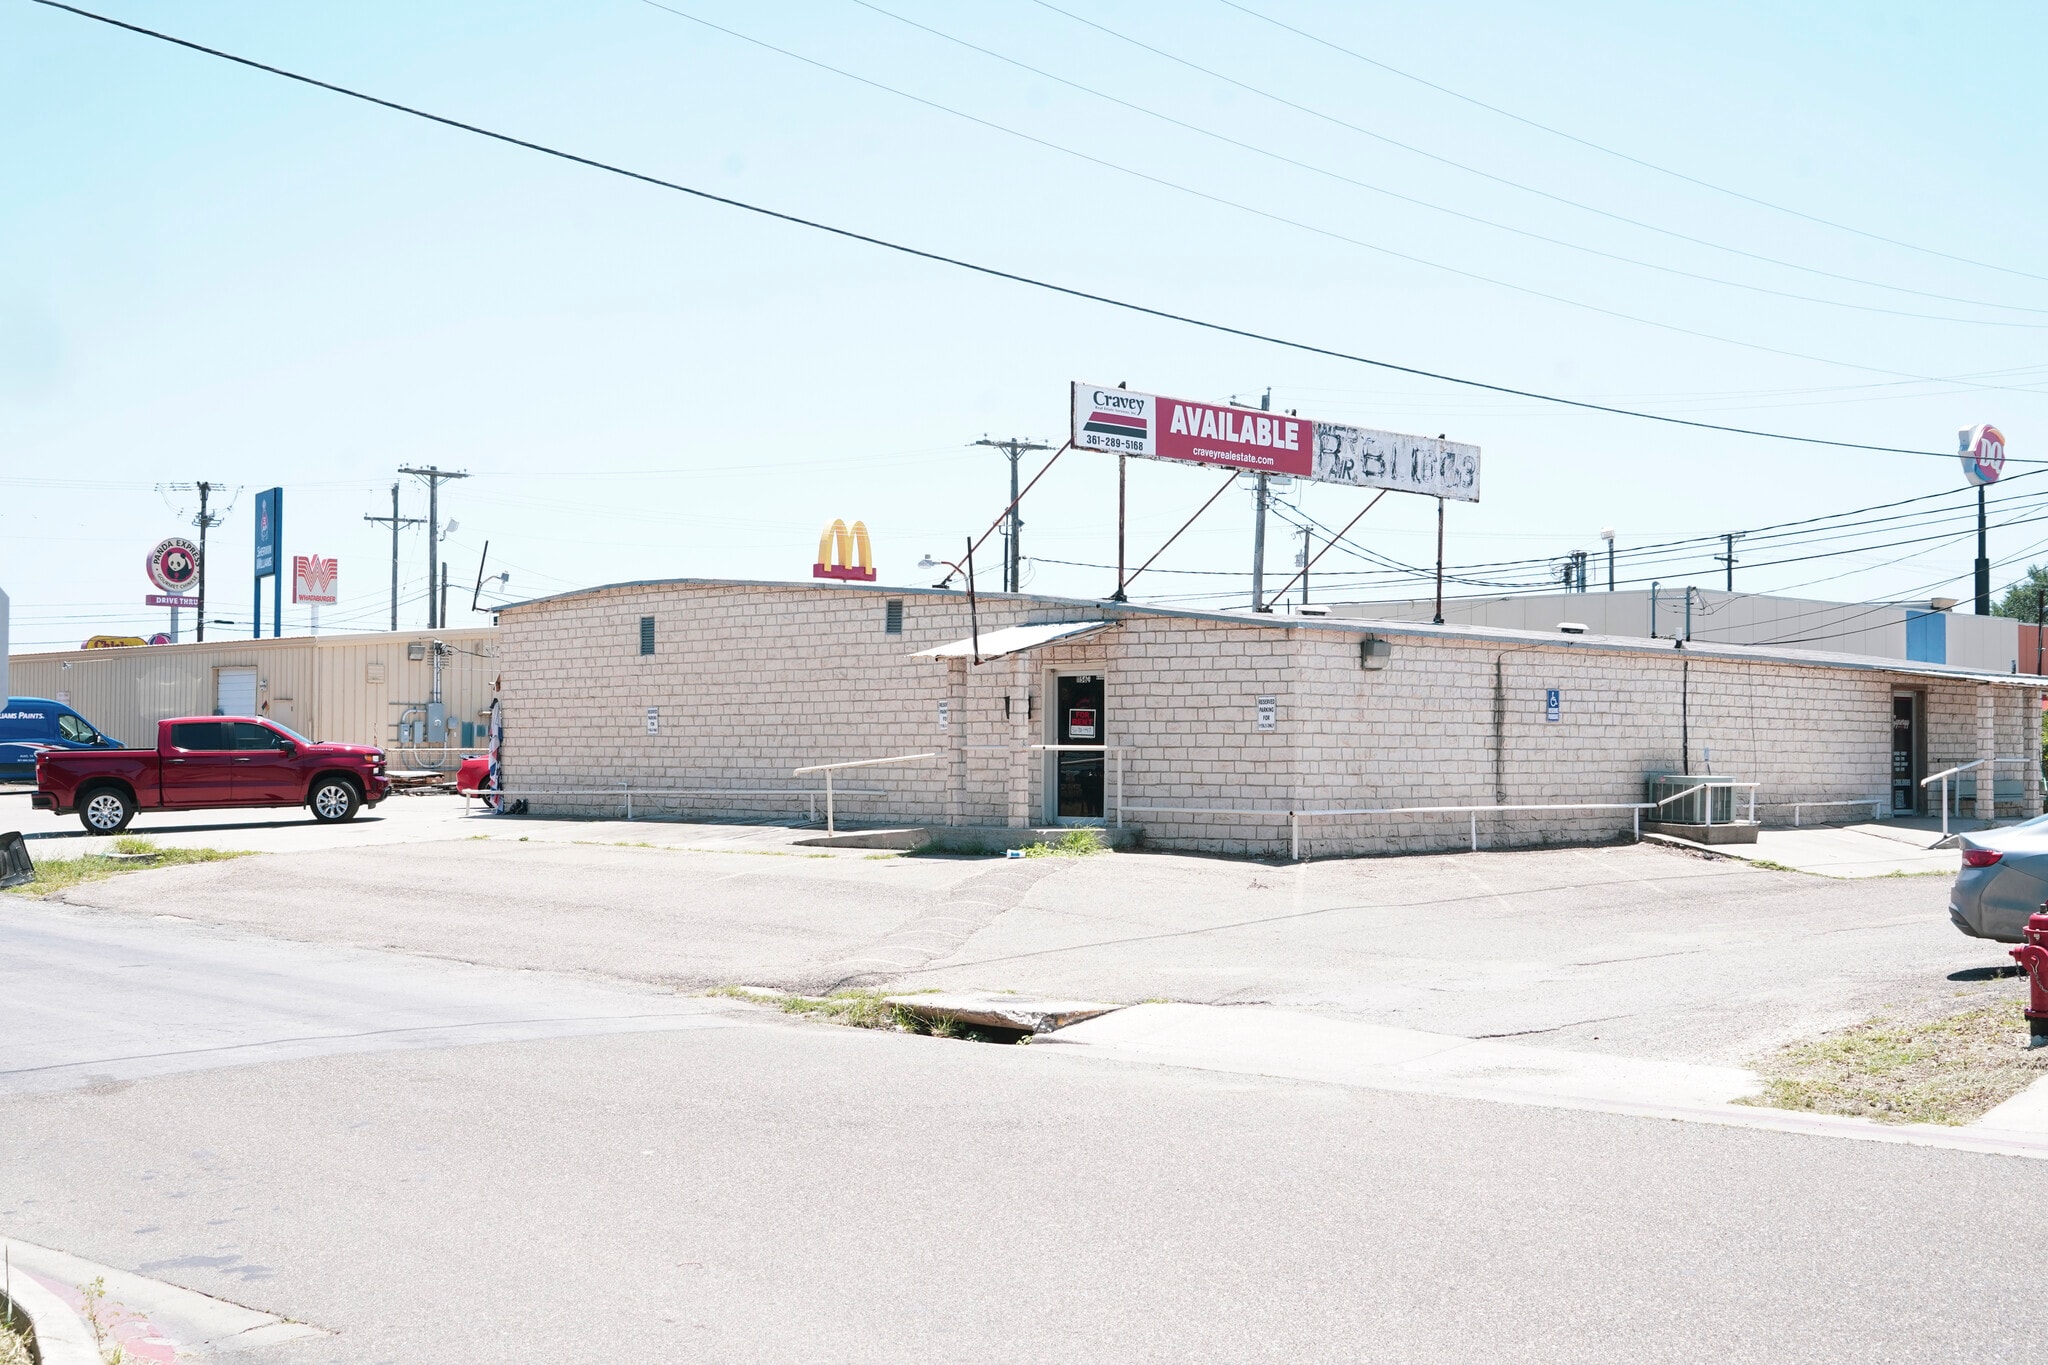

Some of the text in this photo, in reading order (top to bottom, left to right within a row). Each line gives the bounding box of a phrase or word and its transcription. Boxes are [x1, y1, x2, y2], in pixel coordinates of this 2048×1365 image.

[1093, 391, 1145, 416] Cravey
[1170, 404, 1299, 451] AVAILABLE
[1086, 434, 1144, 451] 361-289-5168
[1192, 446, 1274, 466] craveyrealestate.com
[1979, 437, 2003, 475] DQ
[153, 539, 200, 567] PANDA EXPRESS
[157, 573, 179, 590] GOURMET
[156, 596, 199, 605] DRIVE THRU
[298, 594, 336, 602] WHATABURGER
